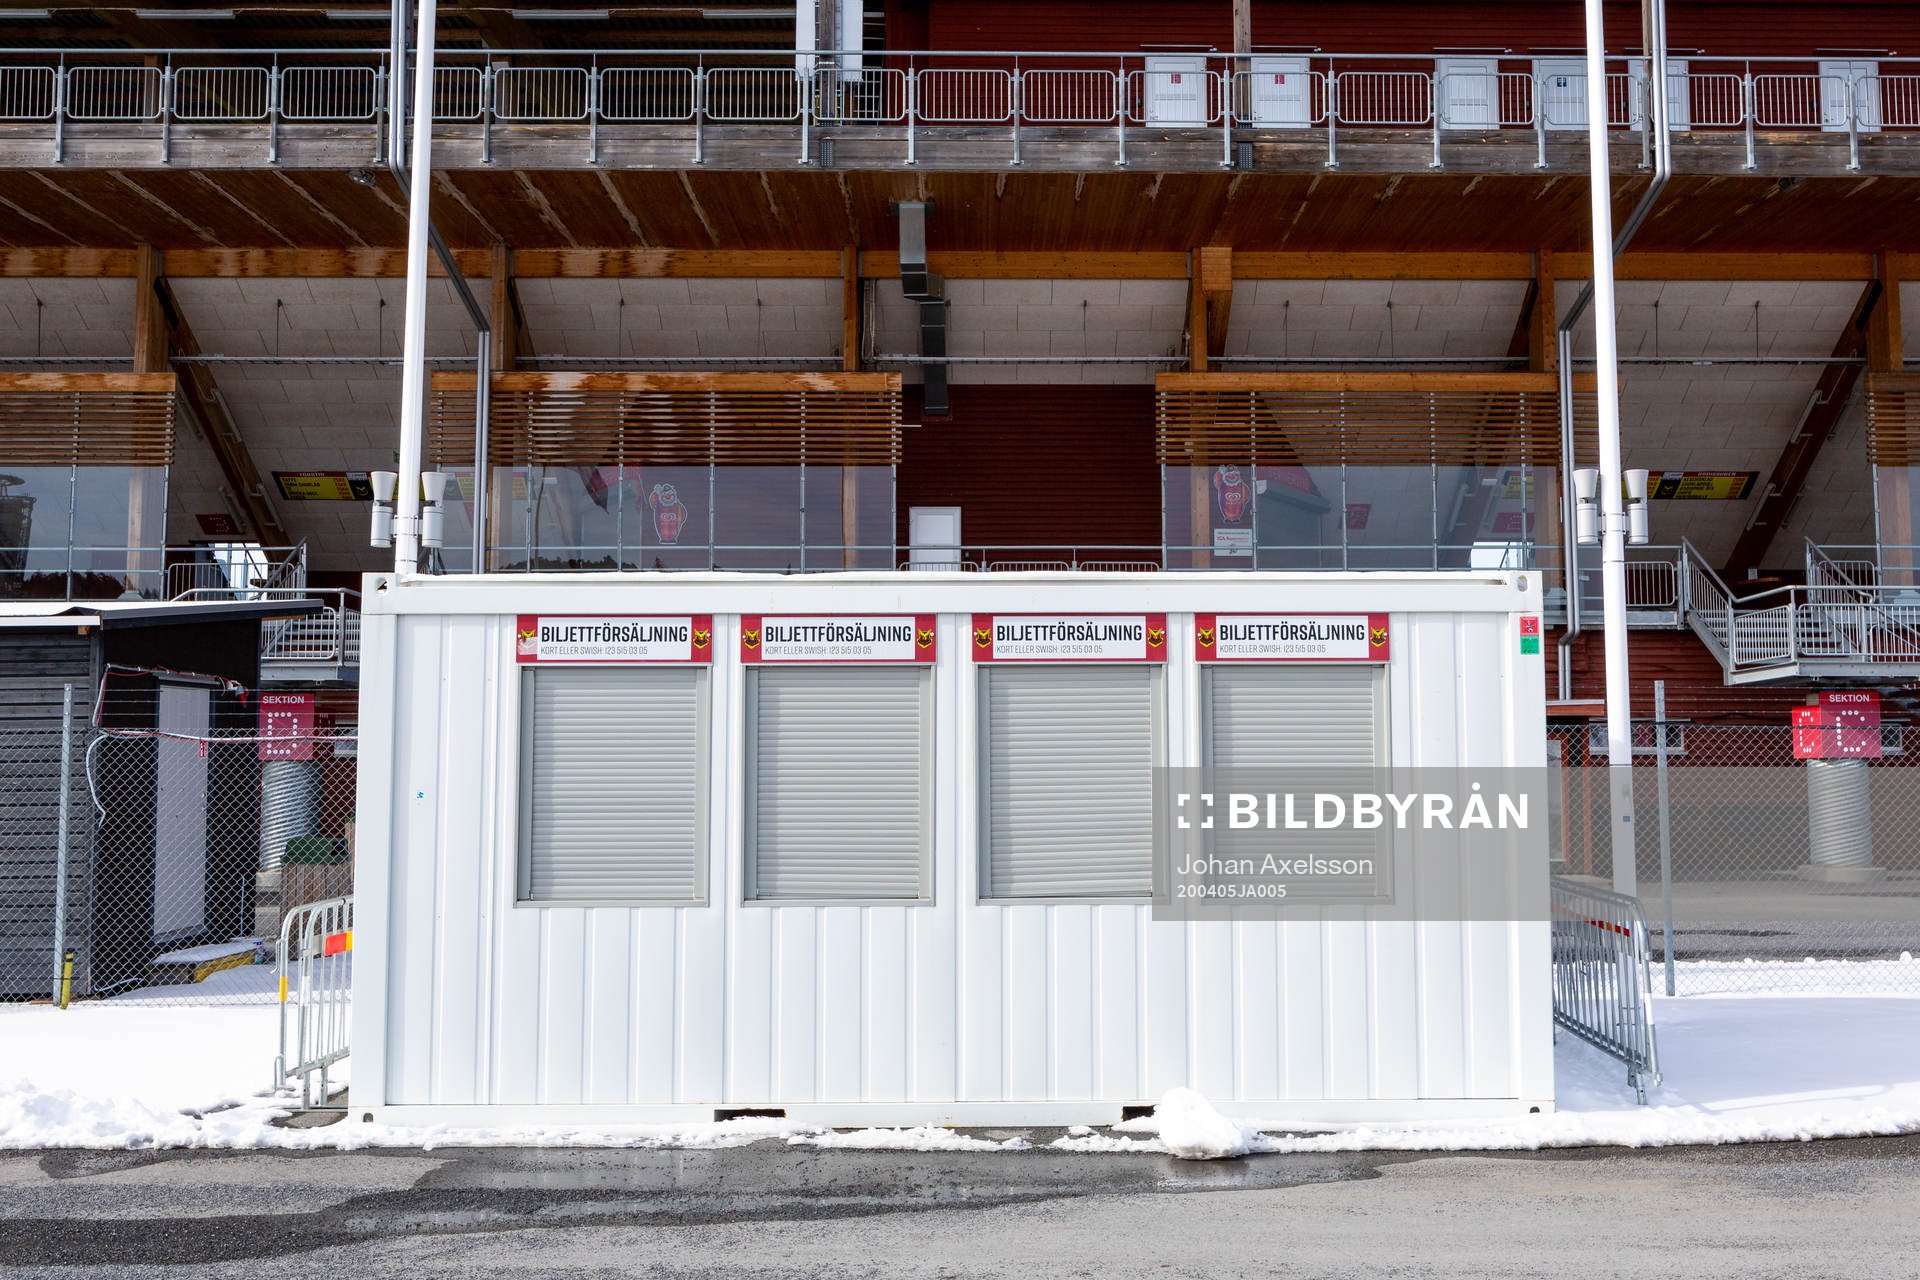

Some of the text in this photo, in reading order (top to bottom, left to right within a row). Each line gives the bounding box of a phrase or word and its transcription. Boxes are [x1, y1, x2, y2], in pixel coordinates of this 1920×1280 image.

[541, 622, 688, 643] BILJETTFÖRSÄLJNING
[765, 622, 912, 642] BILJETTFÖRSÄLJNING
[997, 621, 1142, 641] BILJETTFÖRSÄLJNING
[1220, 621, 1365, 641] BILJETTFÖRSÄLJNING
[541, 646, 558, 654] KORT
[560, 646, 578, 654] ELLER
[605, 646, 615, 654] 123
[616, 646, 628, 654] 515
[629, 646, 638, 654] 03
[639, 646, 648, 654] 05
[766, 646, 782, 654] KORT
[784, 646, 802, 654] ELLER
[829, 646, 840, 654] 123
[841, 646, 852, 654] 515
[853, 646, 862, 654] 03
[863, 646, 872, 654] 05
[996, 645, 1012, 654] KORT
[1015, 645, 1034, 654] ELLER
[1061, 645, 1070, 654] 123
[1072, 645, 1082, 654] 515
[1084, 645, 1092, 654] 03
[1094, 645, 1102, 654] 05
[1220, 644, 1236, 653] KORT
[1238, 644, 1258, 653] ELLER
[1284, 644, 1294, 653] 123
[1295, 644, 1306, 653] 515
[1308, 644, 1316, 653] 03
[1317, 644, 1326, 653] 05
[262, 696, 304, 704] SEKTION
[1829, 694, 1870, 702] SEKTION
[1836, 710, 1866, 752] C
